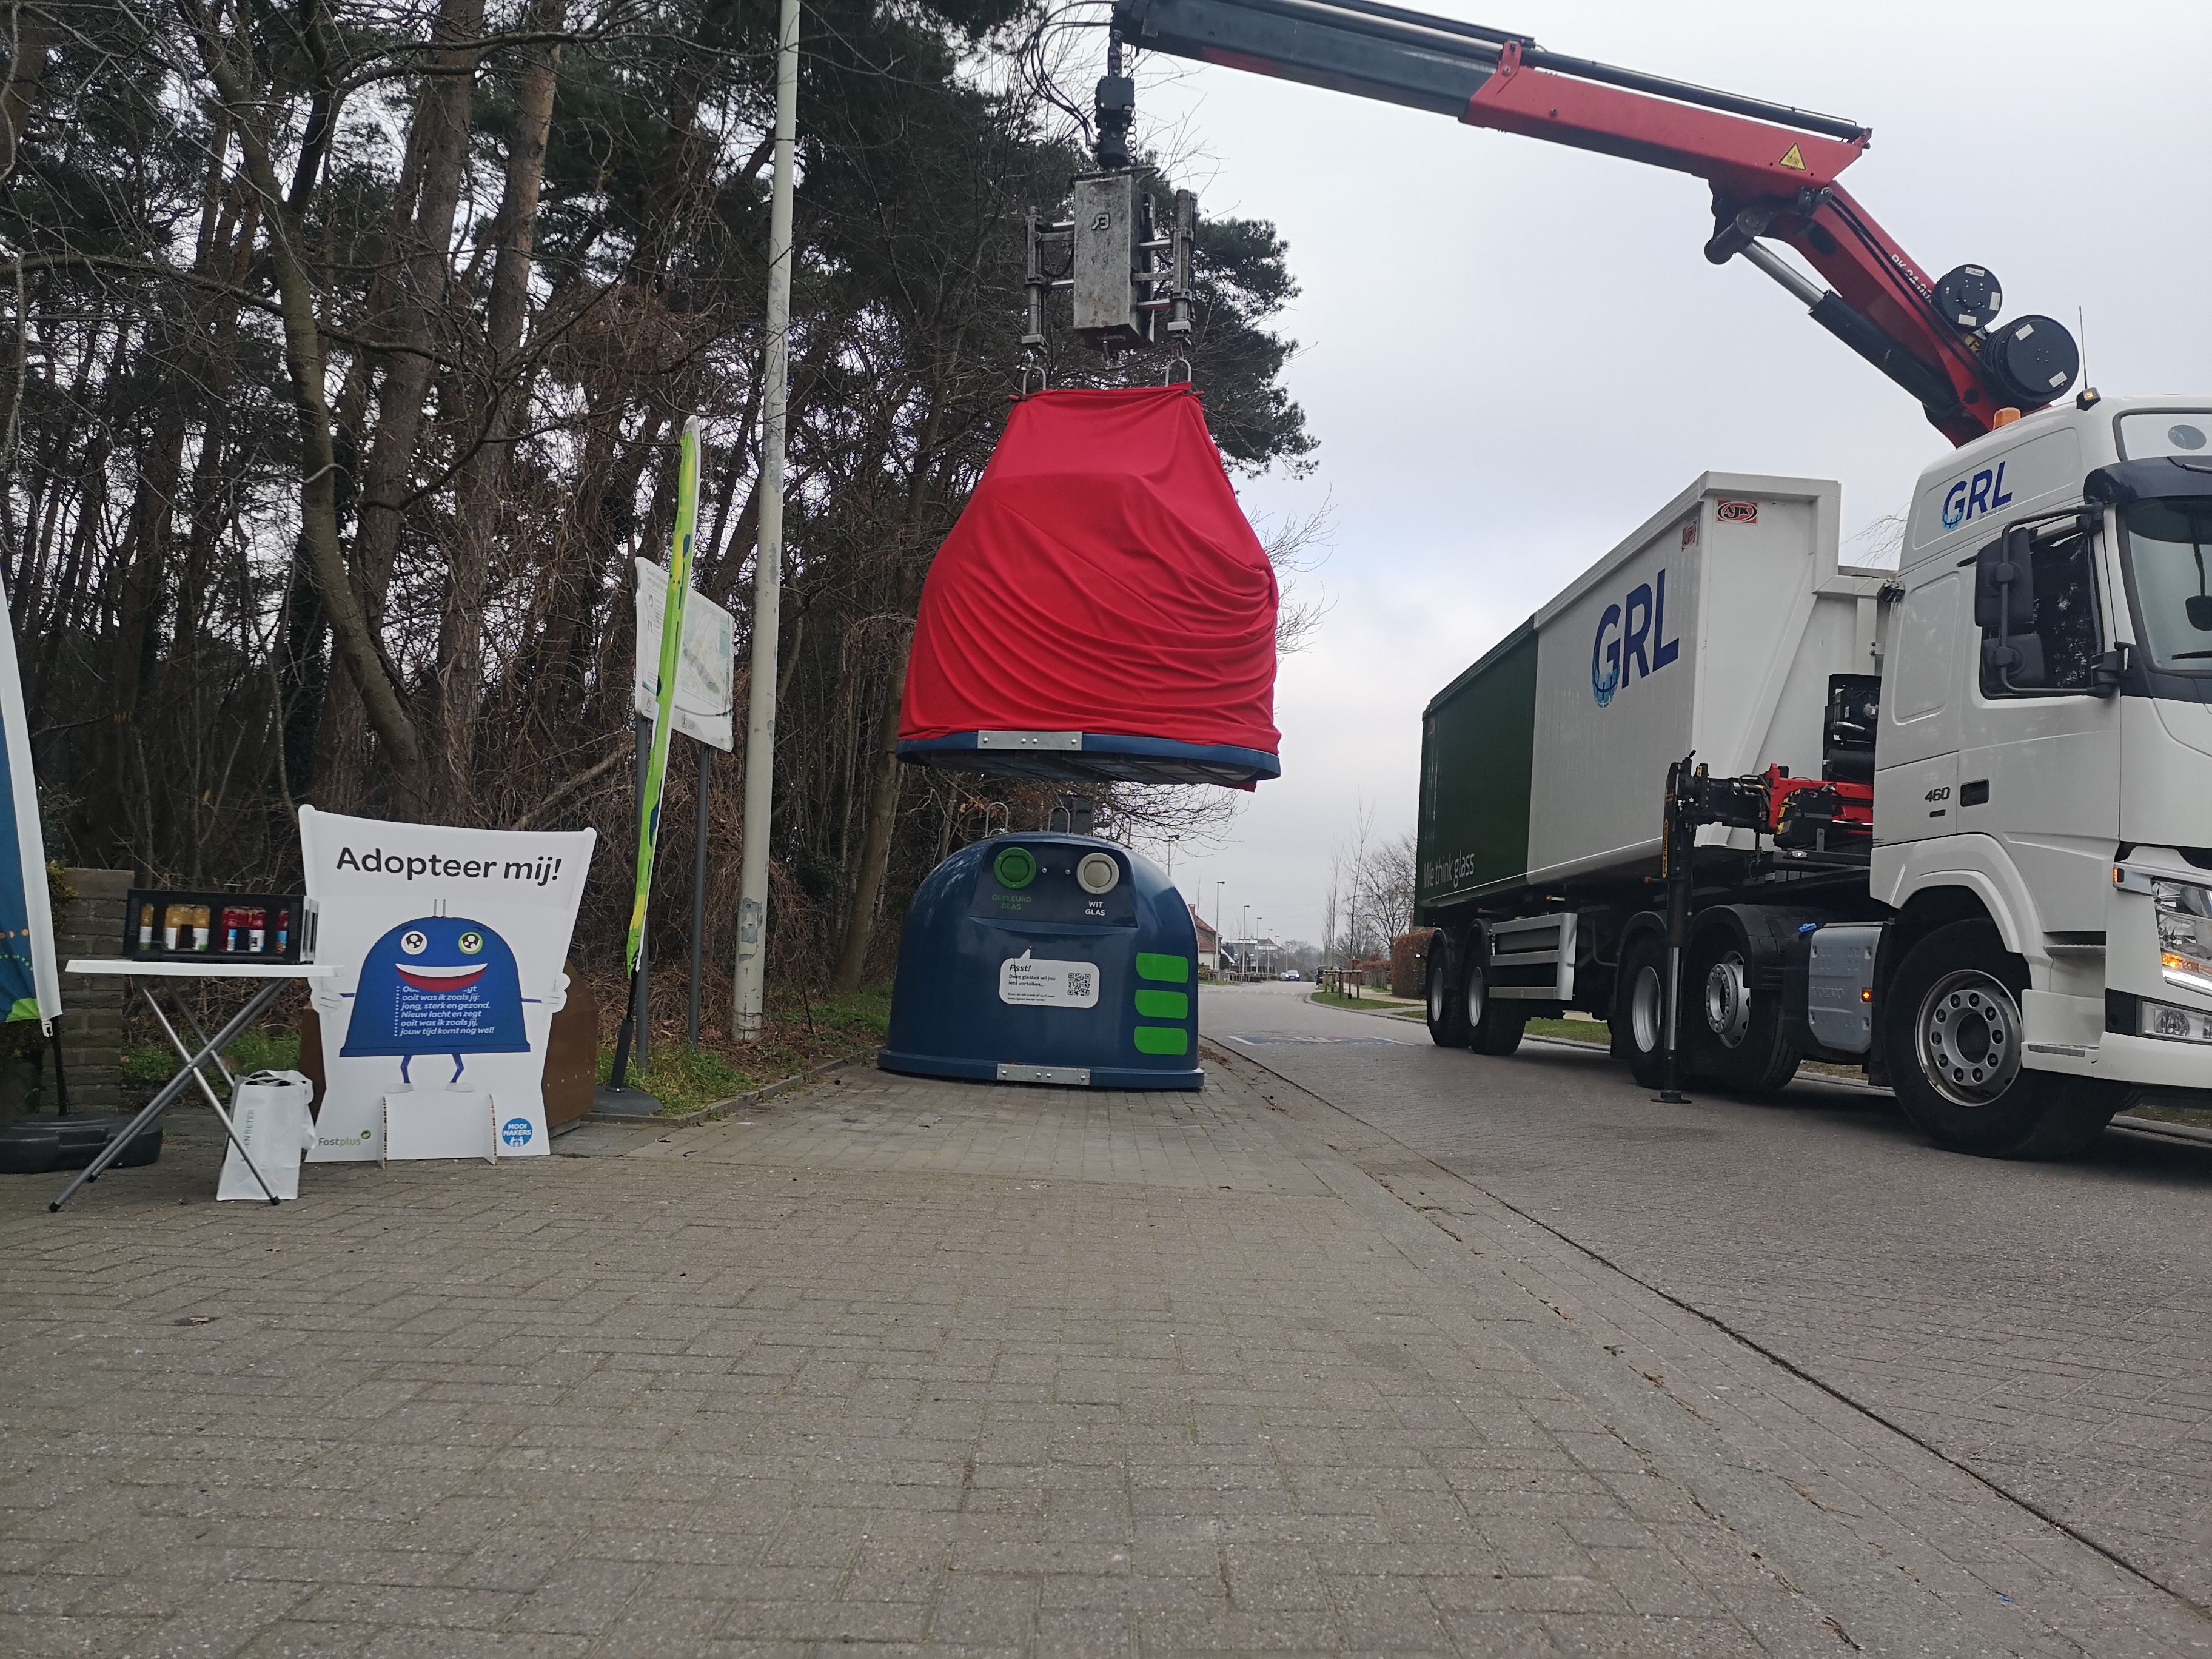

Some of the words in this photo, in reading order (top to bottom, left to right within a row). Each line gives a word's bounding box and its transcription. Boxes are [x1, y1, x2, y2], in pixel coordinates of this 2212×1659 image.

[1942, 461, 2013, 532] GRL
[1723, 506, 1749, 519] AJK
[1592, 568, 1679, 708] GRL
[1925, 786, 1950, 802] 460
[337, 847, 497, 880] Adopteer
[504, 856, 562, 886] mij!
[1424, 862, 1434, 888] We
[1435, 853, 1453, 885] think
[1453, 849, 1475, 888] glass
[991, 894, 1031, 903] GEKLEURD
[469, 993, 480, 1002] jij:
[400, 1002, 423, 1011] jong,
[458, 1001, 491, 1010] gezond.
[463, 1010, 482, 1019] zegt
[399, 1028, 421, 1037] jouw
[422, 1028, 437, 1036] tijd
